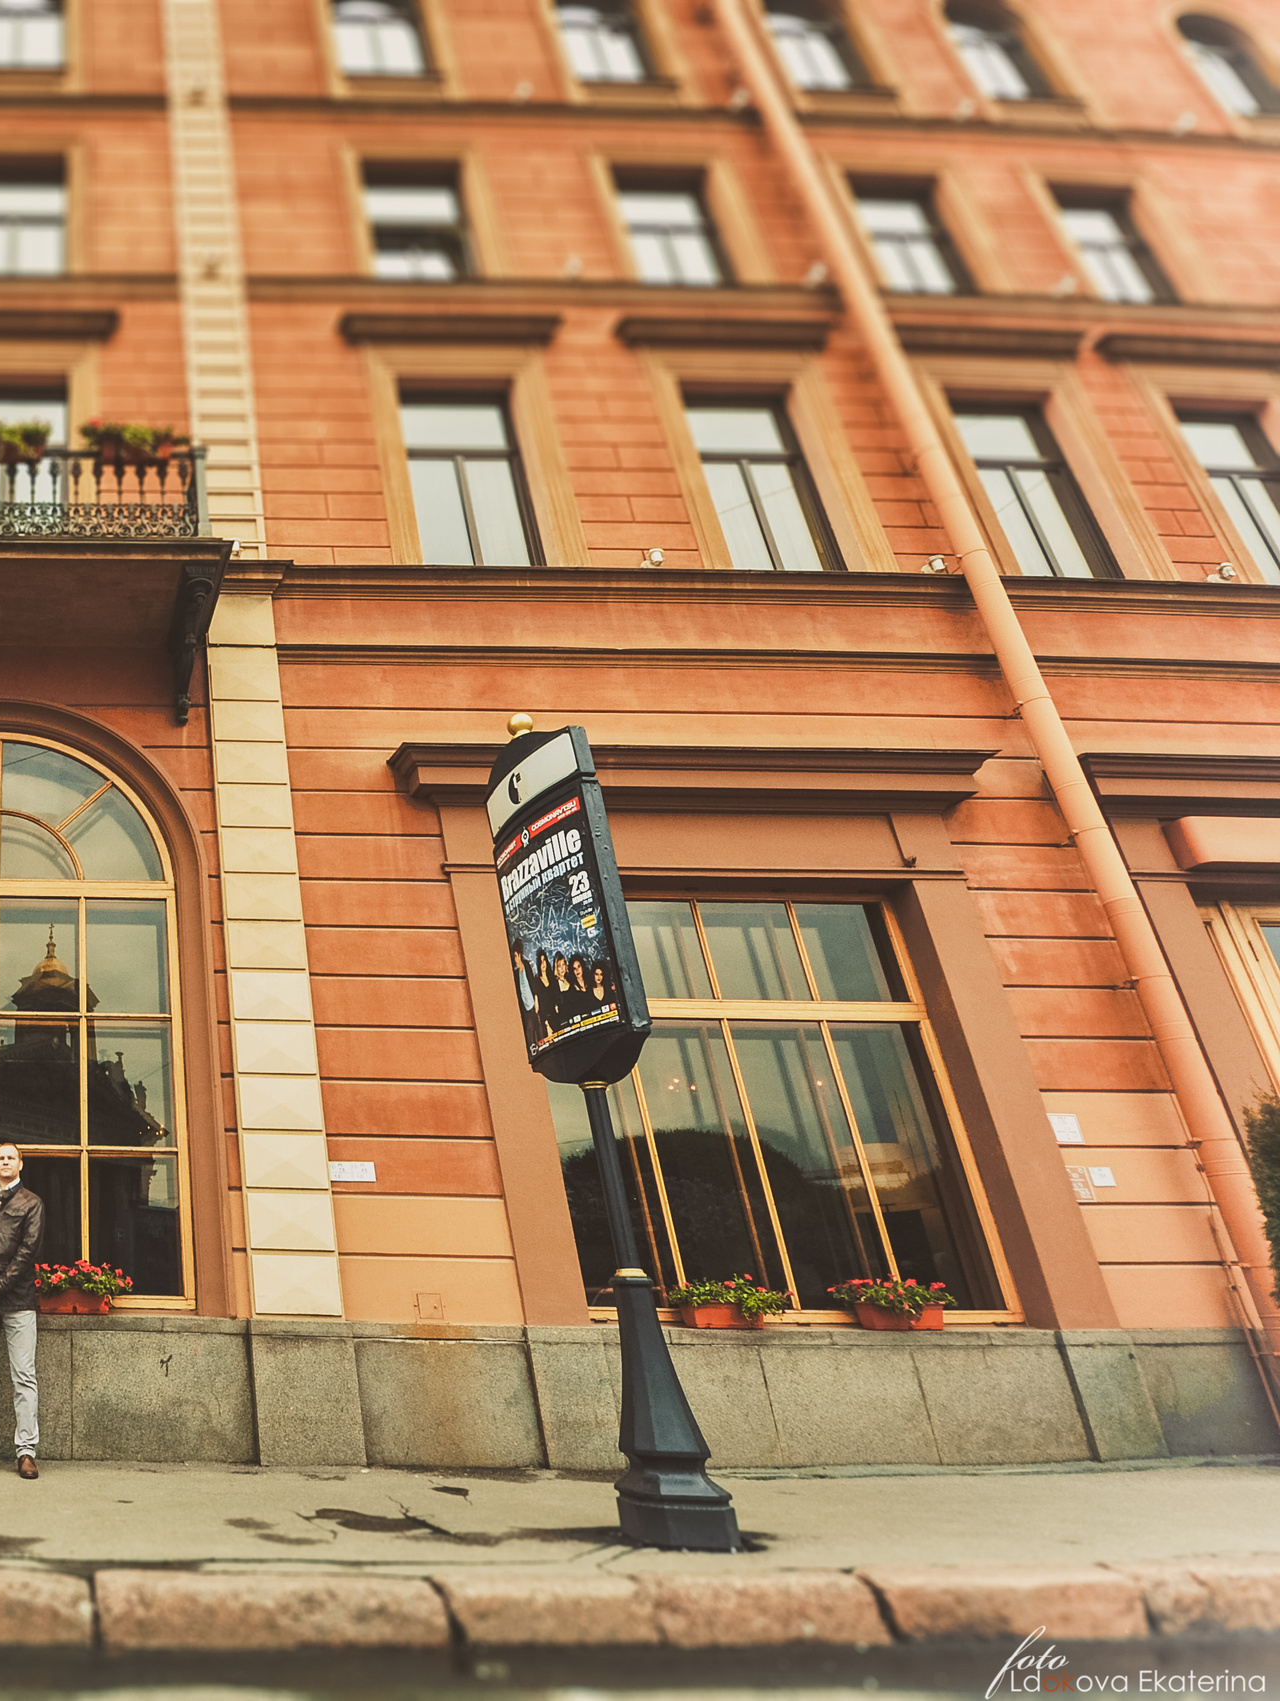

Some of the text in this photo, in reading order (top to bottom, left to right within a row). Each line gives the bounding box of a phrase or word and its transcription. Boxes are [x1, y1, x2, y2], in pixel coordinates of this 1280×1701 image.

[500, 828, 582, 903] Brazzaville
[541, 851, 584, 885] квартет
[568, 870, 590, 897] 23
